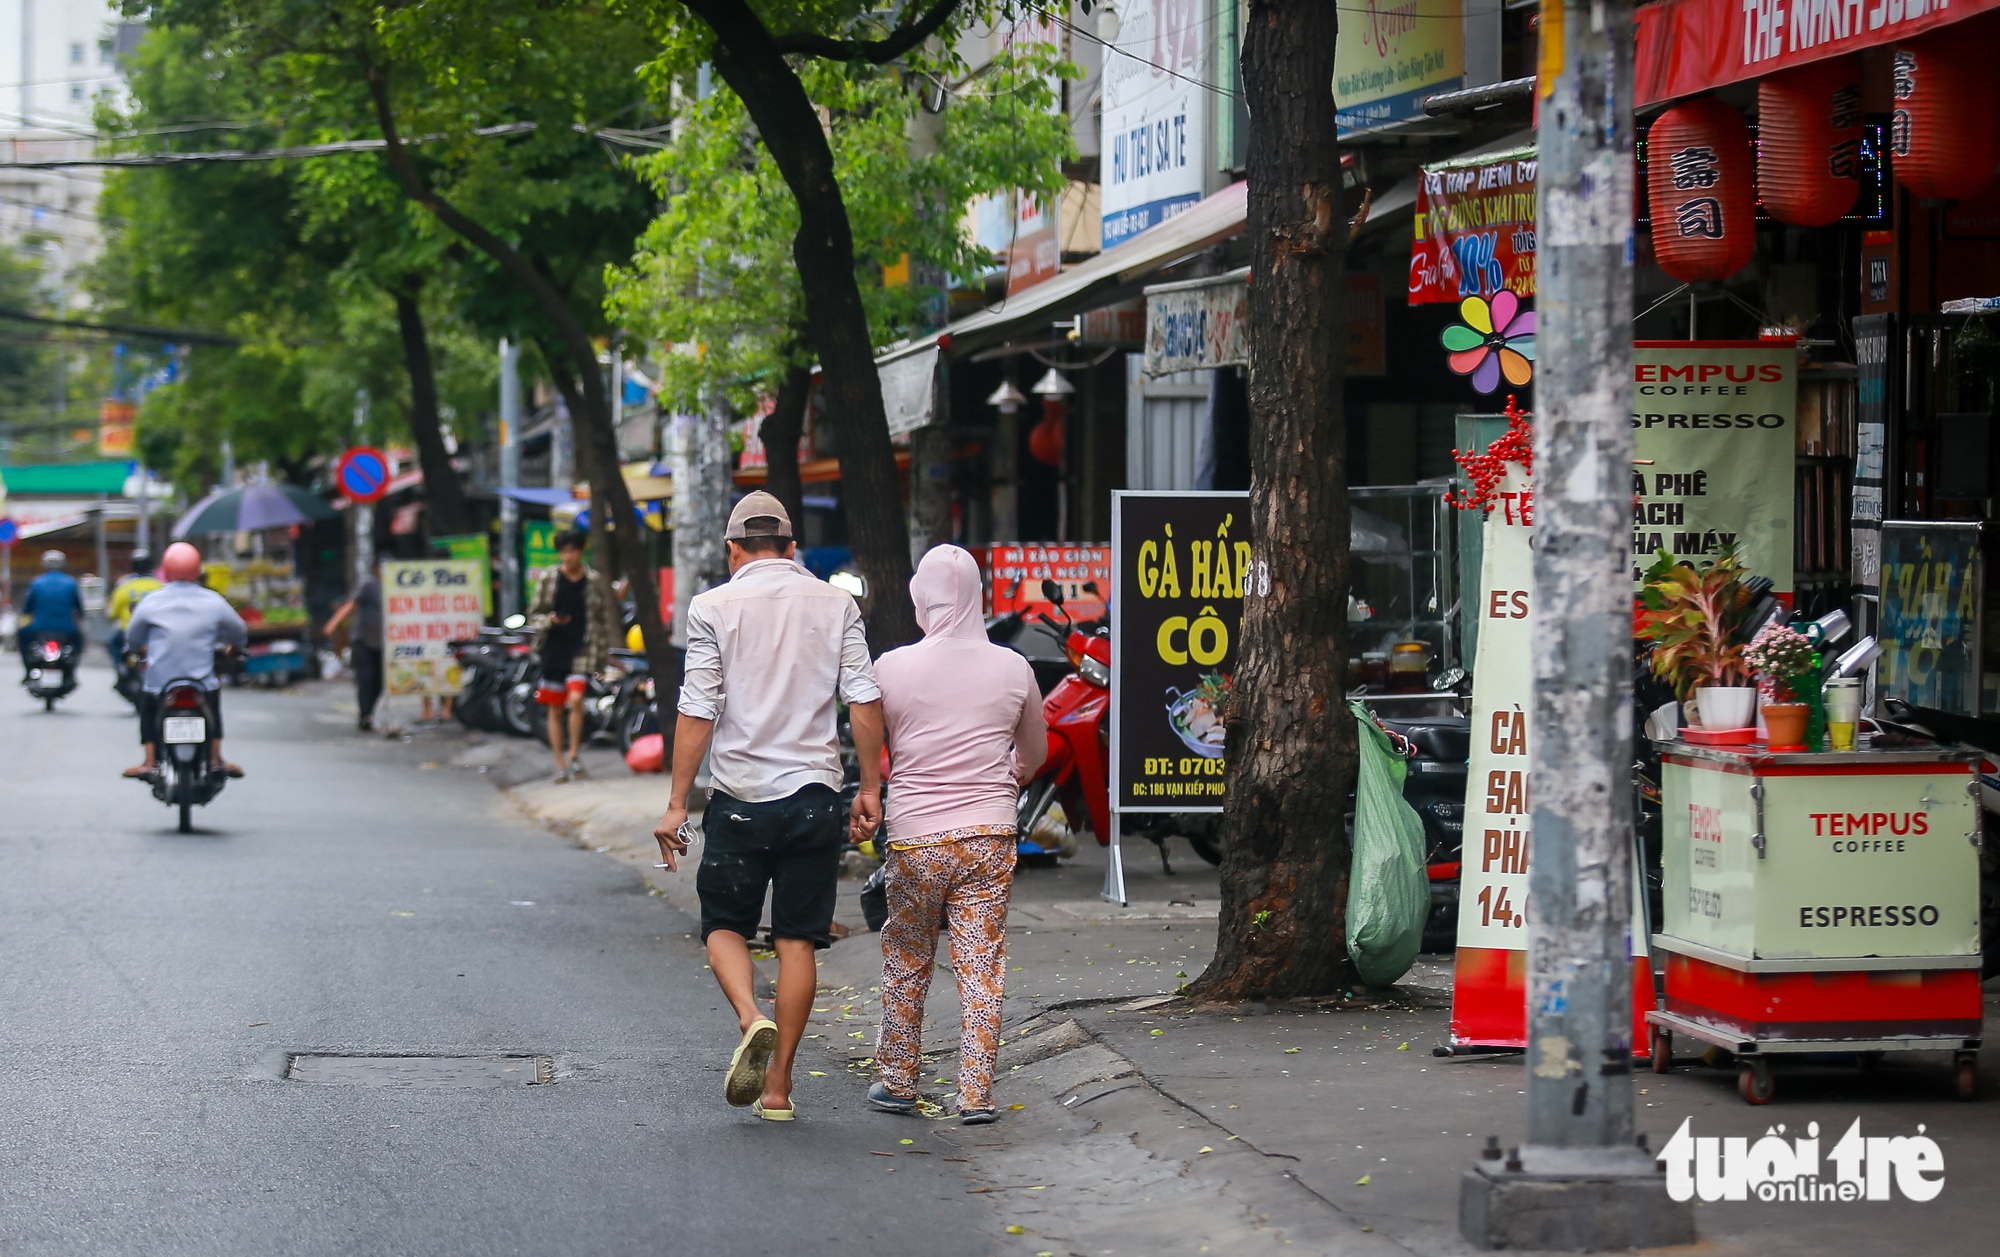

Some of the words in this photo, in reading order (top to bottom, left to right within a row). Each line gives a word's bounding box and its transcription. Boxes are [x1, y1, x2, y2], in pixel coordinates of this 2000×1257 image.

[1484, 193, 1512, 226] KHAI
[1452, 231, 1504, 297] 10%
[1639, 385, 1748, 396] COFFEE
[1655, 469, 1708, 496] PHÊ
[1137, 522, 1182, 599] GÀ
[1190, 512, 1252, 599] HẤP
[1488, 590, 1529, 619] ES
[1156, 605, 1229, 666] CÔ
[1490, 703, 1527, 755] CÀ
[1144, 757, 1174, 776] ĐT:
[1809, 811, 1929, 836] TEMPUS
[1833, 840, 1906, 853] COFFEE
[1800, 904, 1940, 928] ESPRESSO
